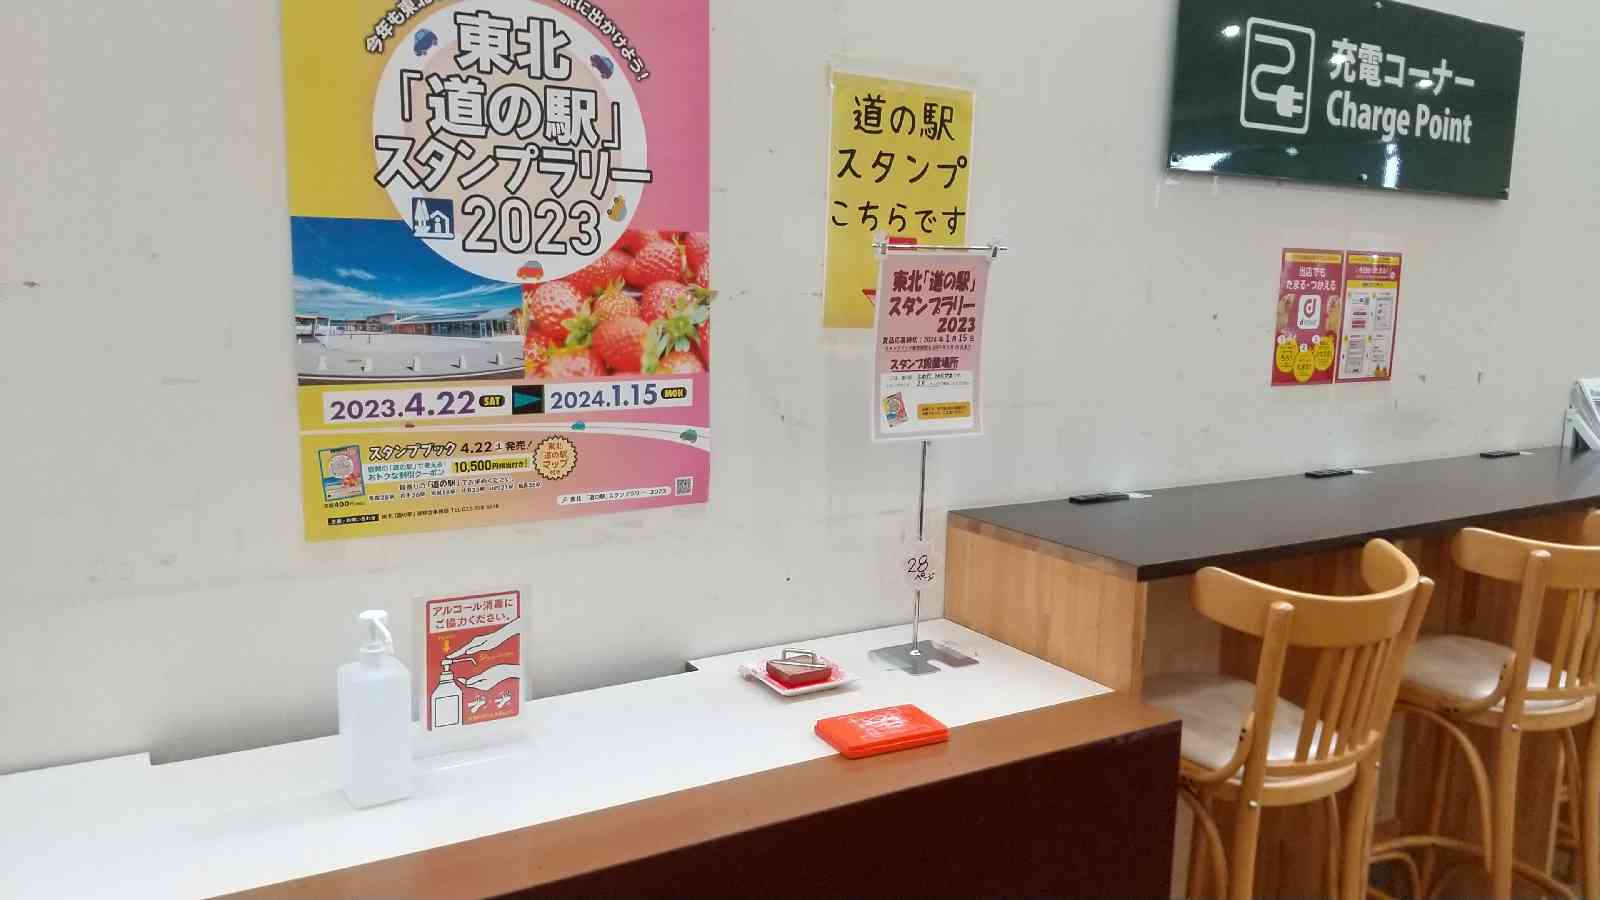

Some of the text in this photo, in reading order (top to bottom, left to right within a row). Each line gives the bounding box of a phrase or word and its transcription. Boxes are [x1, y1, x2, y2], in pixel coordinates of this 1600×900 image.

[453, 10, 573, 80] 東北
[1328, 37, 1475, 96] 充電コーナー
[399, 70, 622, 150] 「道の駅」
[852, 92, 956, 141] 道の駅
[1326, 90, 1473, 144] Charge Point
[375, 134, 653, 201] スタンプラリー
[836, 148, 968, 189] スタンプ
[461, 194, 603, 256] 2023
[831, 200, 966, 236] こちらです
[892, 270, 976, 292] 東北「道の駅」
[888, 296, 976, 317] スタンプラリー
[936, 316, 976, 333] 2023
[329, 391, 501, 421] 2023.4.22 SAT
[550, 383, 685, 411] 2024.1.15 MON
[368, 441, 458, 461] スタンプブック
[542, 458, 569, 469] マップ
[907, 554, 929, 573] 28
[432, 598, 514, 617] アルコール消毒に
[435, 613, 511, 629] ご協力ください。
